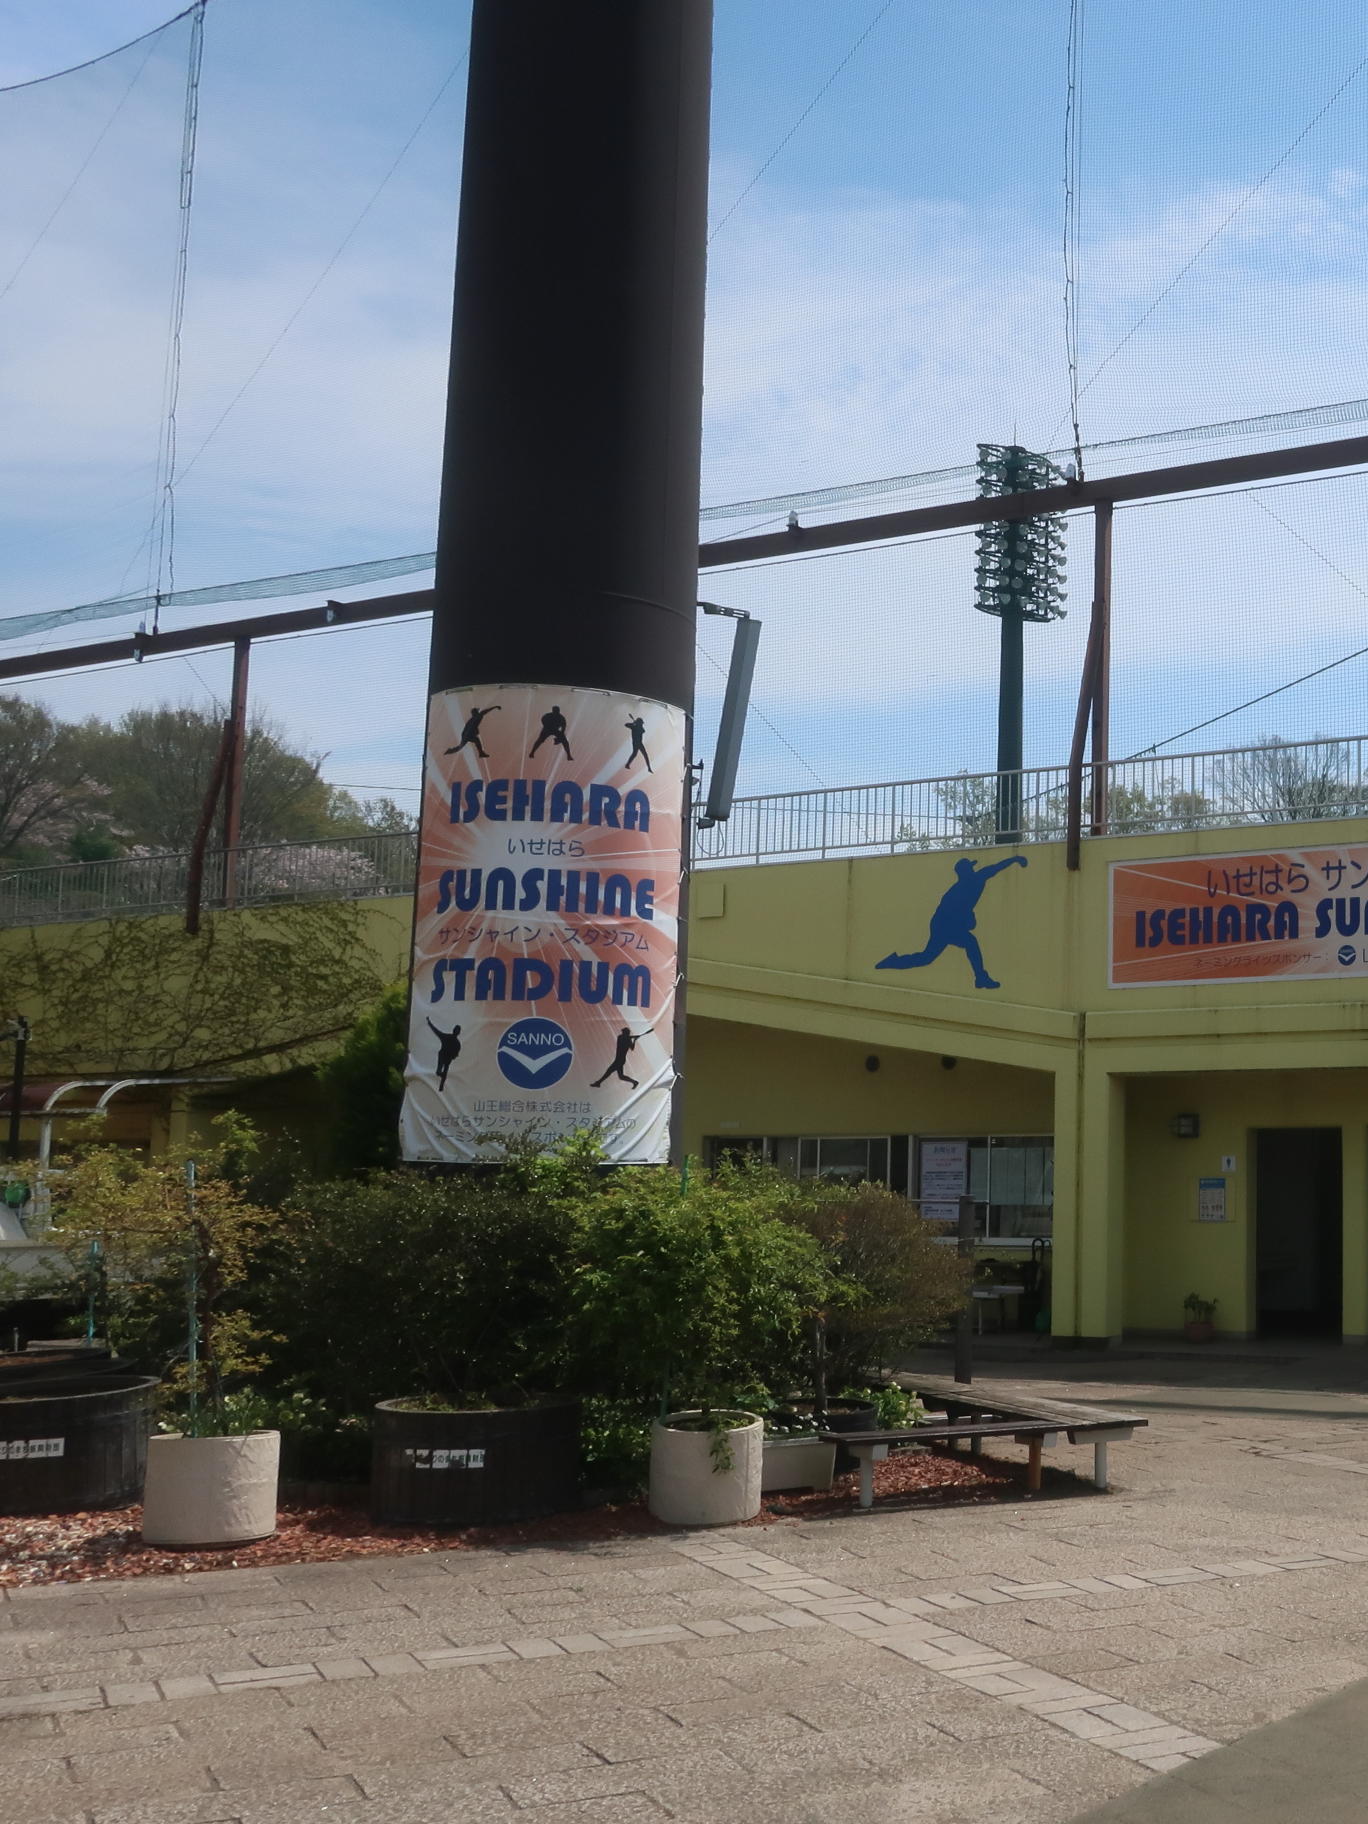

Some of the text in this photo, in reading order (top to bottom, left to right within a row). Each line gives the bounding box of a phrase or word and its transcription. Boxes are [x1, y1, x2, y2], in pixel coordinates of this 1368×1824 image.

[450, 778, 650, 833] ISEHARA
[507, 837, 586, 858] いせはら
[436, 866, 656, 921] SUNSHINE
[1206, 862, 1310, 898] いせはら
[438, 925, 650, 952] サンシャイン・スタジアム
[1135, 900, 1299, 948] ISEHARA
[430, 956, 651, 1009] STADIUM
[507, 1032, 565, 1046] SANNO
[473, 1100, 592, 1114] 山王総合株式会社は
